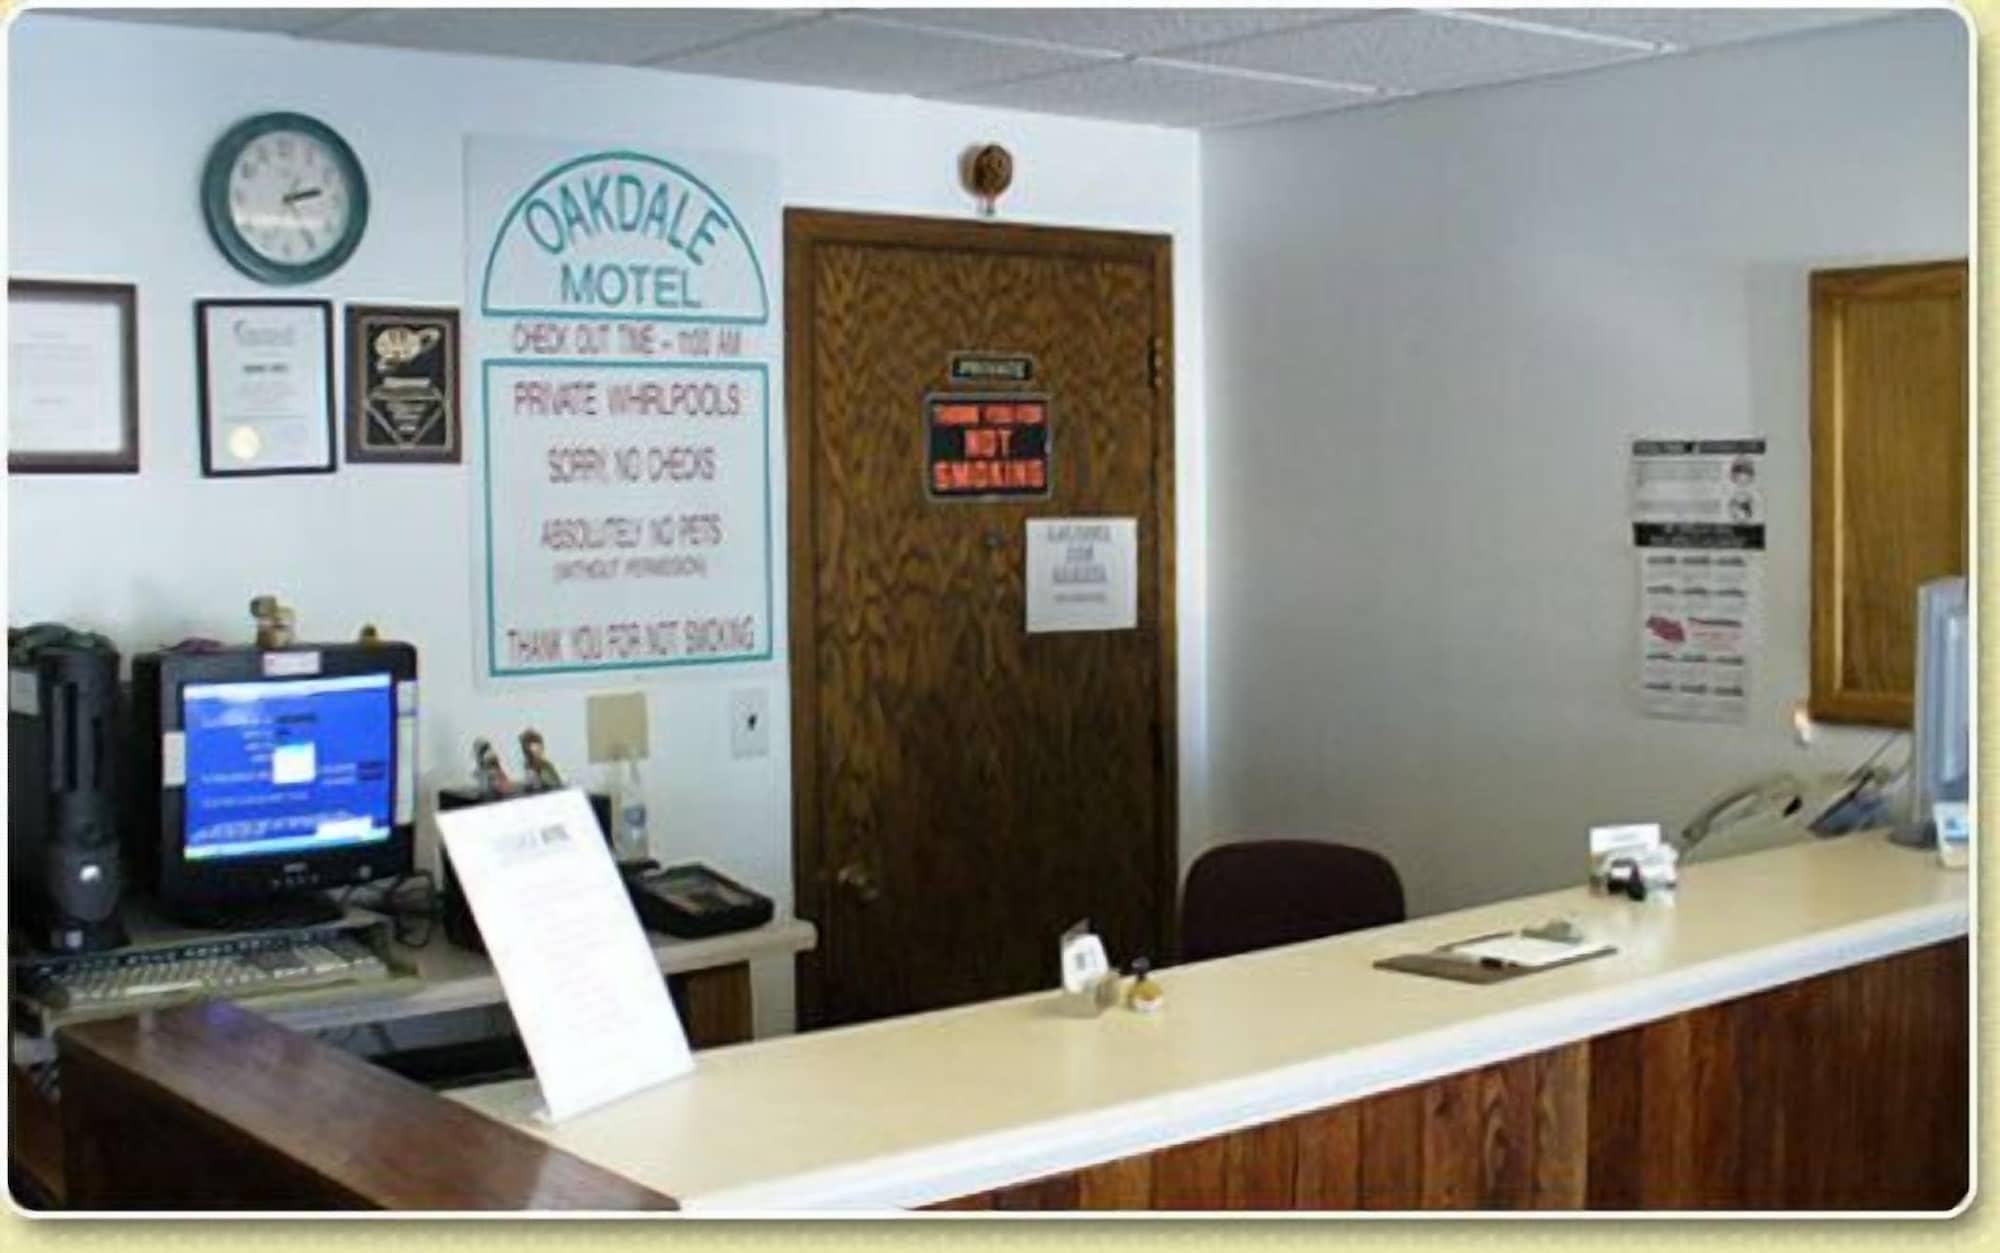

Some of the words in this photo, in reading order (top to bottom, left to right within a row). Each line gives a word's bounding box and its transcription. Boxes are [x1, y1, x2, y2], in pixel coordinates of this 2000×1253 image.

[526, 174, 729, 265] OAKDALE
[561, 263, 703, 308] MOTEL
[512, 322, 567, 354] CHECK
[576, 323, 611, 354] OUT
[618, 323, 655, 354] TIME
[514, 381, 598, 416] PRIVATE
[607, 382, 740, 416] WHIRLPOOLS
[964, 428, 1012, 458] NOT
[614, 446, 640, 482] NO
[647, 446, 716, 481] CHECKS
[933, 460, 1044, 492] SMOKING
[541, 516, 641, 550] ABSOLUTELY
[650, 515, 673, 547] NO
[679, 513, 723, 547] PETS
[506, 627, 562, 663] THANK
[571, 624, 602, 660] YOU
[608, 622, 641, 657] FOR
[646, 619, 678, 655] NOT
[685, 614, 755, 653] SMOKING
